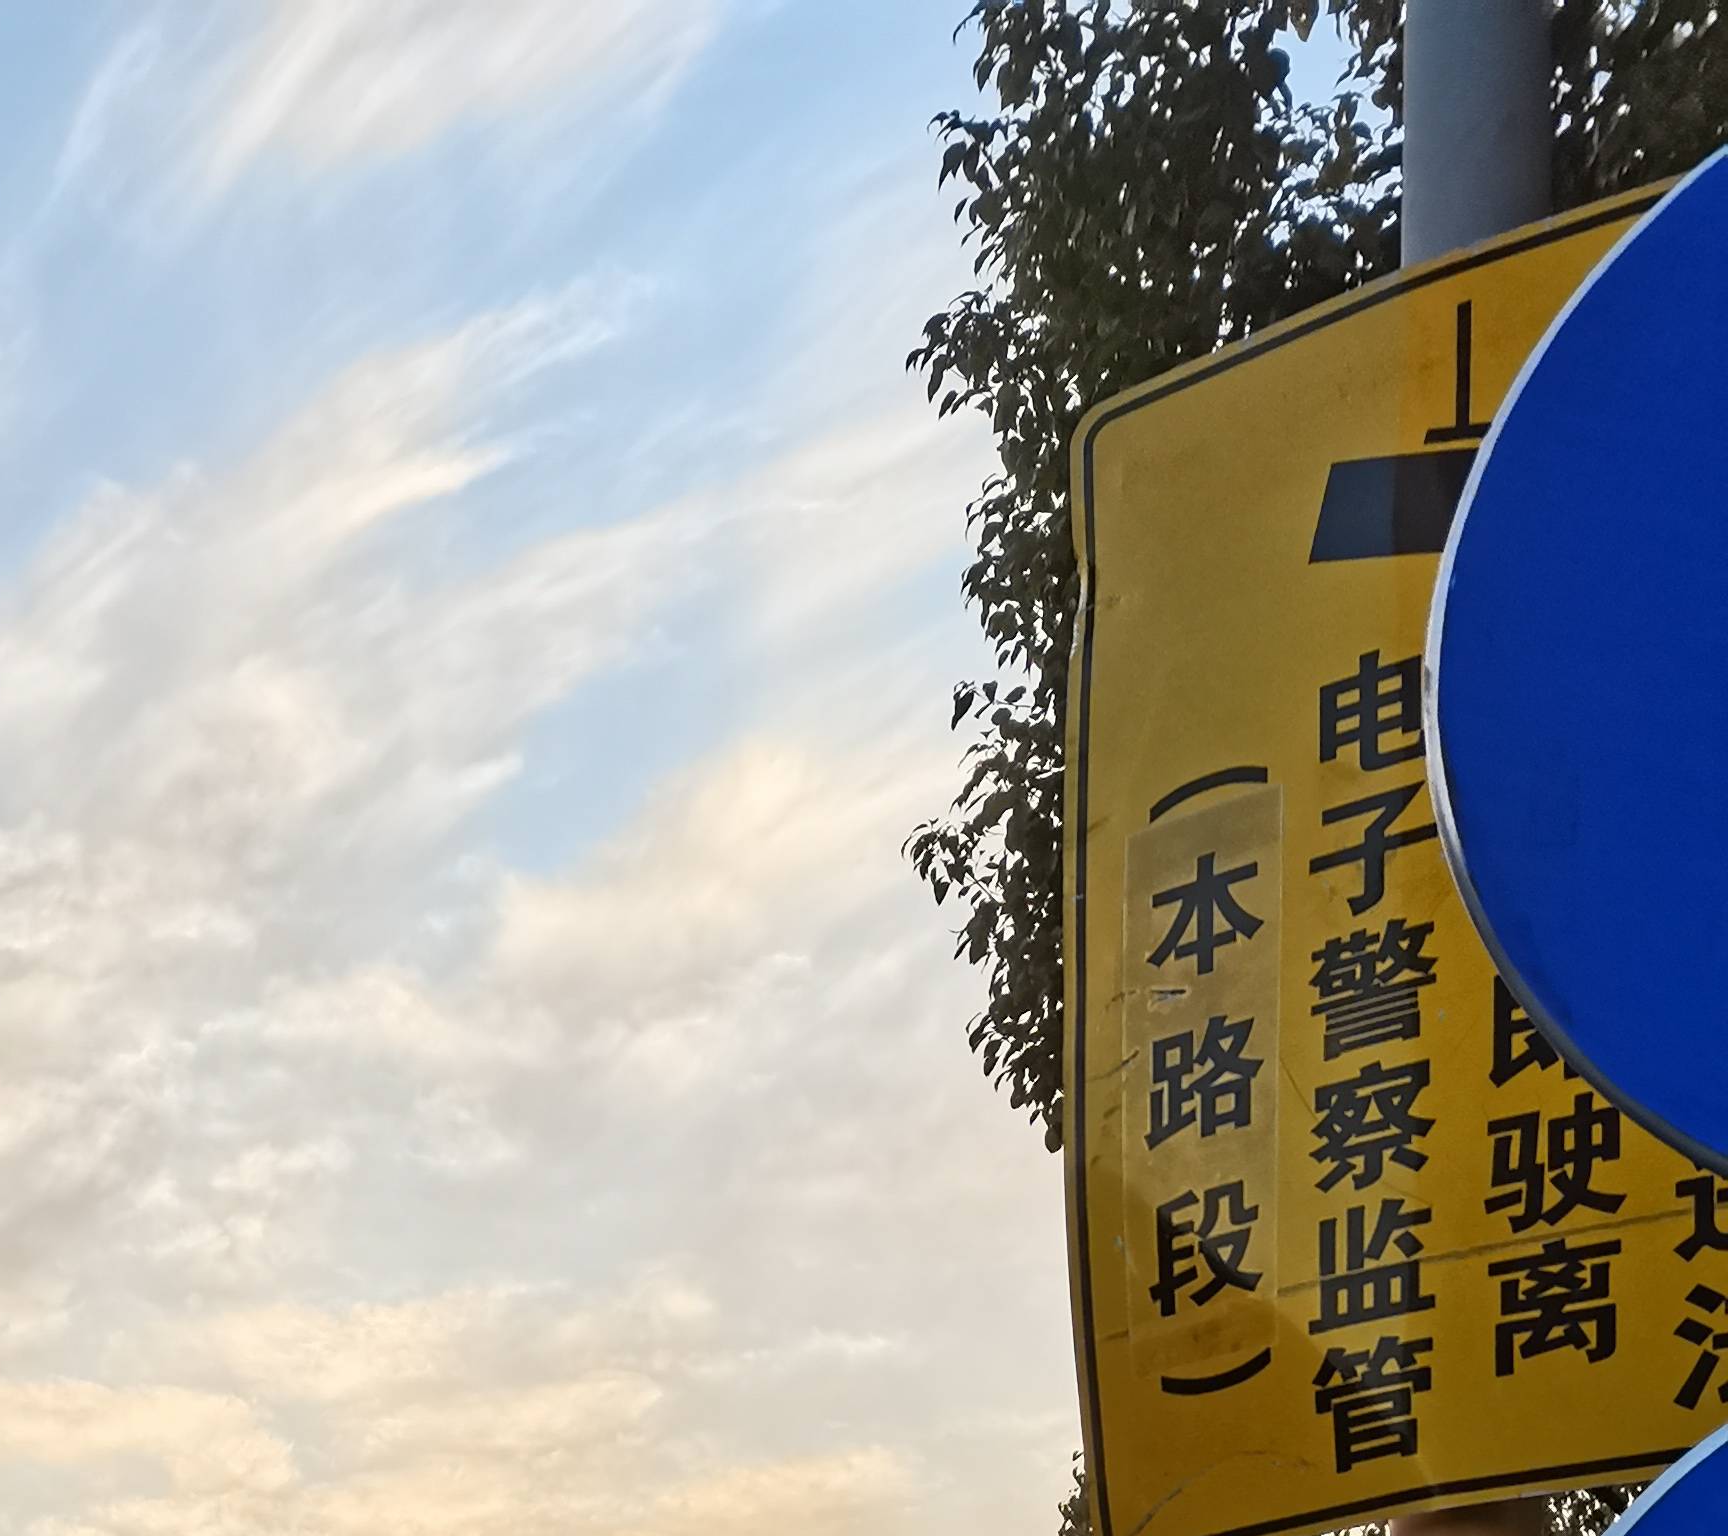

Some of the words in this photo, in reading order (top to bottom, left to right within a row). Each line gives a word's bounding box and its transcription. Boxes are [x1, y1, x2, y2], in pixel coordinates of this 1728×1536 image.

[1309, 649, 1438, 1473] 电子警察监管
